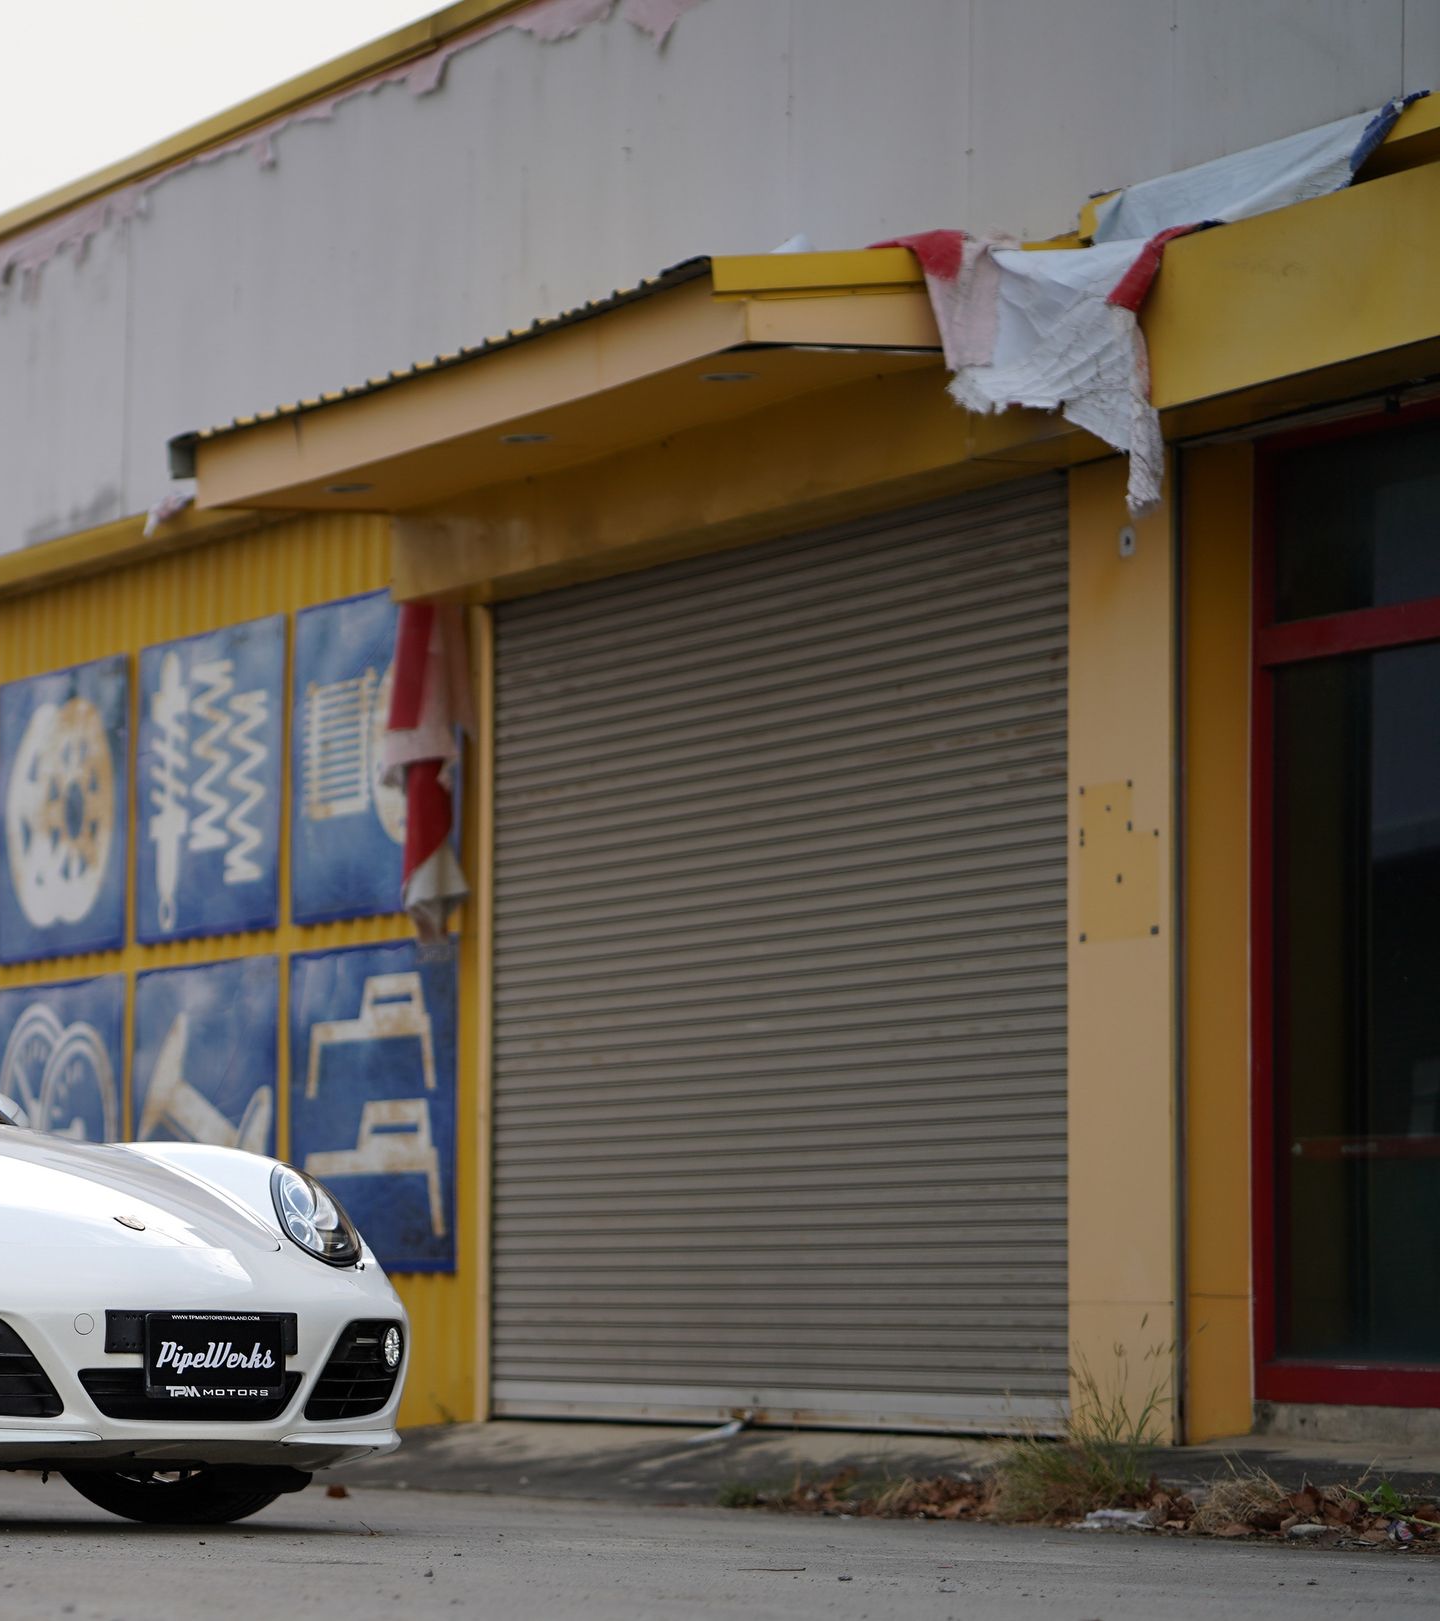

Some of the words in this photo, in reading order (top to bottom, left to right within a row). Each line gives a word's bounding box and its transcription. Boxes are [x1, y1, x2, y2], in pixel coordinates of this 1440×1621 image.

[155, 1341, 276, 1375] PipeWerks
[165, 1385, 201, 1398] TPM
[203, 1388, 269, 1397] MOTORS
